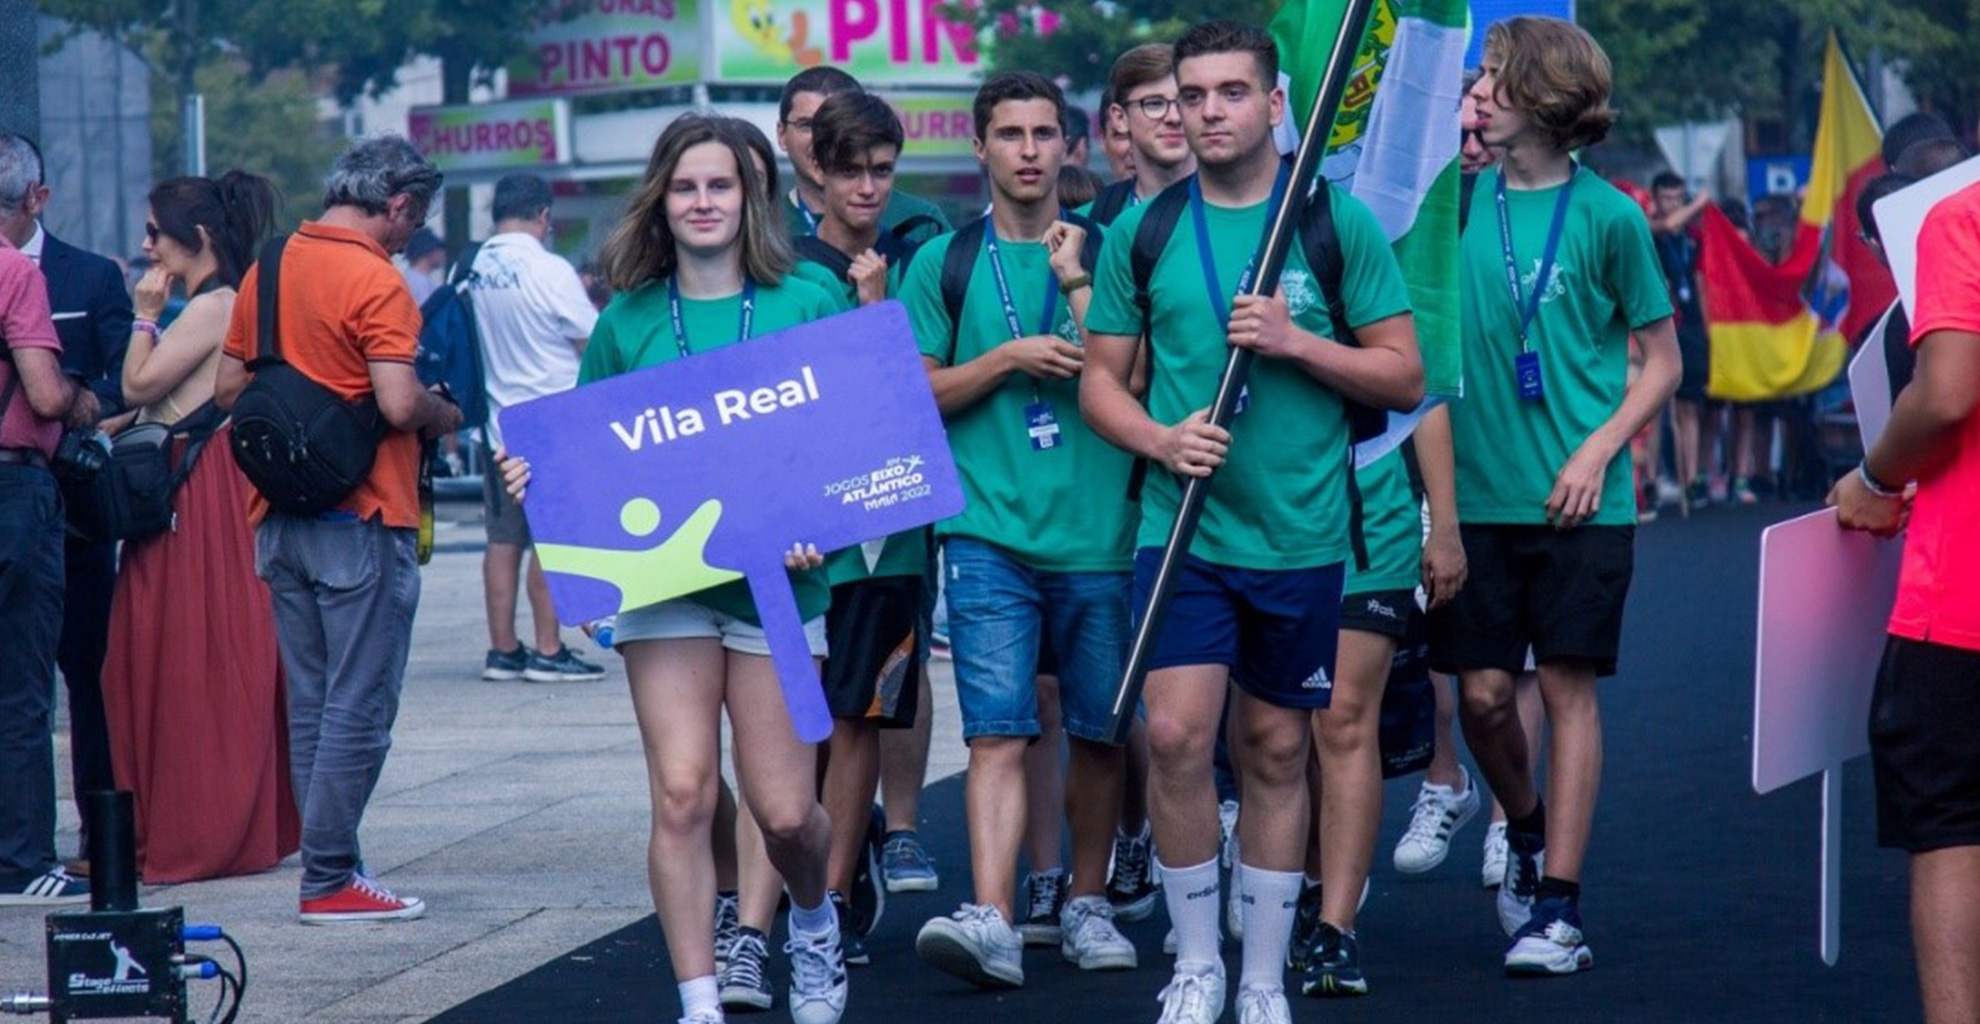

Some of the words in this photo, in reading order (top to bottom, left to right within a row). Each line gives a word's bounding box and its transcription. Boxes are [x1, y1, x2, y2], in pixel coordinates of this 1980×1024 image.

[829, 0, 1062, 64] PIN
[541, 33, 670, 82] PINTO
[610, 407, 705, 450] Vila
[714, 366, 819, 424] Real
[823, 475, 869, 497] JOGOS
[871, 465, 905, 482] EIXO
[900, 483, 932, 502] 2022
[68, 973, 112, 990] Stage
